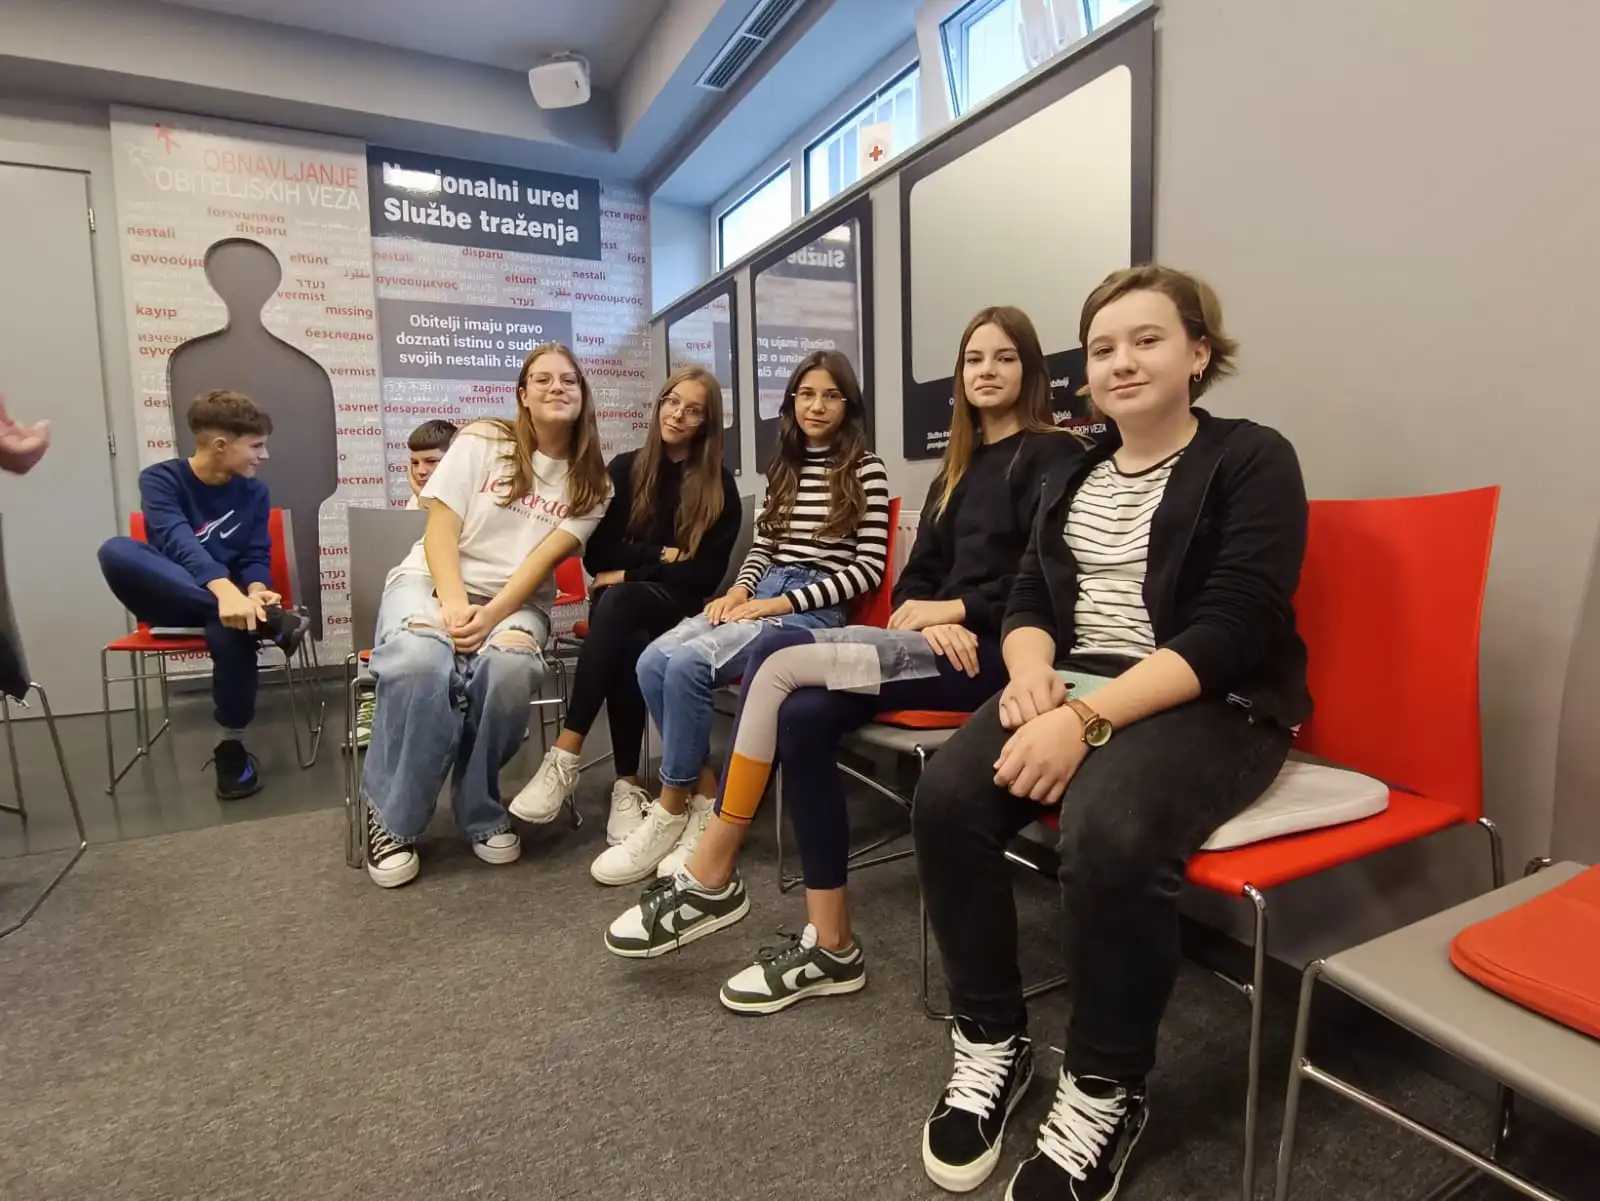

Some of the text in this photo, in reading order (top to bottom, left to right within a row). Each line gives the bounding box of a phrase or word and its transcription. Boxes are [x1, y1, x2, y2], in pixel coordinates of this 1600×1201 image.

[203, 148, 360, 189] OBNAVLJANJE
[154, 166, 362, 211] OBITELJSKIH VEZA
[526, 185, 580, 211] ured
[383, 197, 472, 229] Službe
[479, 210, 580, 247] traženja
[126, 225, 176, 240] nestali
[235, 222, 288, 238] disparu
[374, 251, 412, 264] nestali
[462, 246, 504, 261] disparu
[572, 270, 606, 282] nestali
[276, 289, 327, 303] vermist
[325, 305, 375, 320] missing
[409, 314, 543, 336] Obitelji imaju pravo
[304, 328, 375, 342] безследно
[396, 331, 451, 347] doznati
[453, 333, 493, 349] istinu
[495, 339, 505, 349] o
[399, 350, 443, 368] svojih
[446, 353, 502, 369] nestalih
[329, 366, 377, 378] vermist
[337, 402, 379, 413] savnet
[458, 395, 505, 405] vermisst
[383, 403, 461, 417] desaparecido
